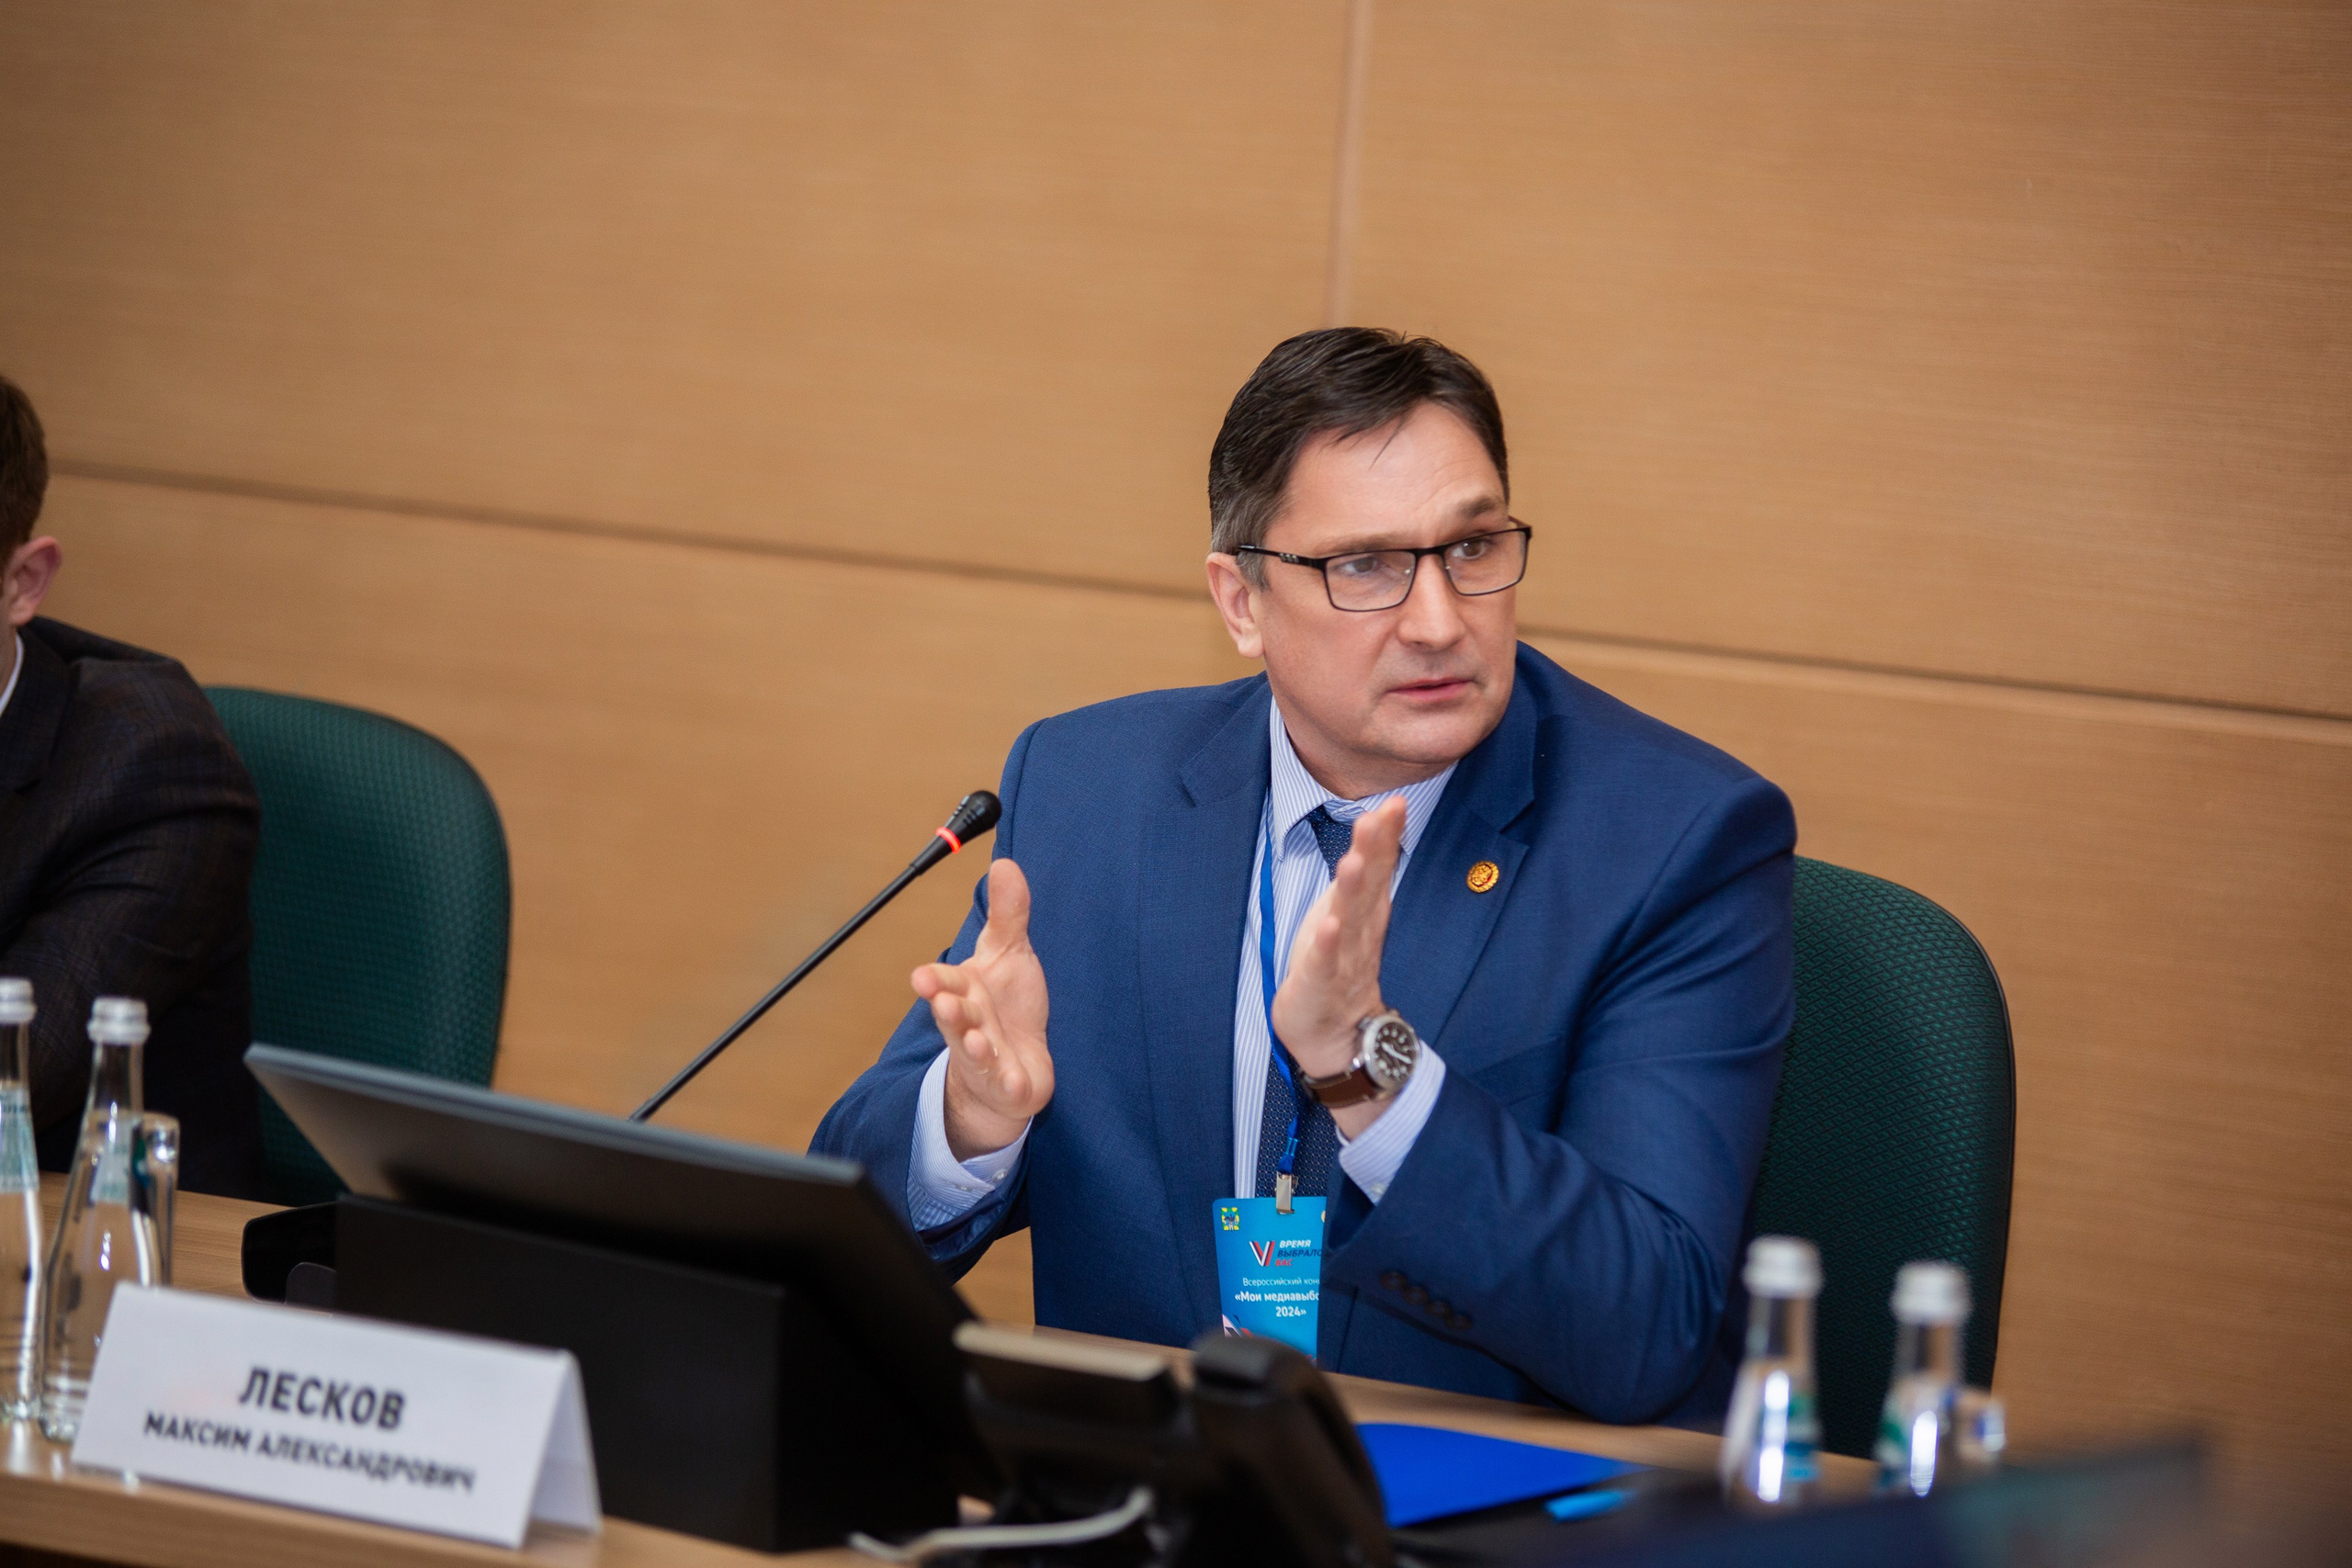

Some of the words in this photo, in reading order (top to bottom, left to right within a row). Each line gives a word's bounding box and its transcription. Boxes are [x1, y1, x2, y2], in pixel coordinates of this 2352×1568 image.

[1280, 1239, 1311, 1248] ВРЕМЯ
[1243, 1277, 1301, 1287] Всероссийский
[1235, 1291, 1261, 1302] «Мои
[1276, 1306, 1306, 1316] 2024»
[238, 1366, 407, 1432] ЛЕСКОВ
[144, 1412, 251, 1452] МАКСИМ
[256, 1434, 475, 1493] АЛЕКСАНДРОВИЧ
